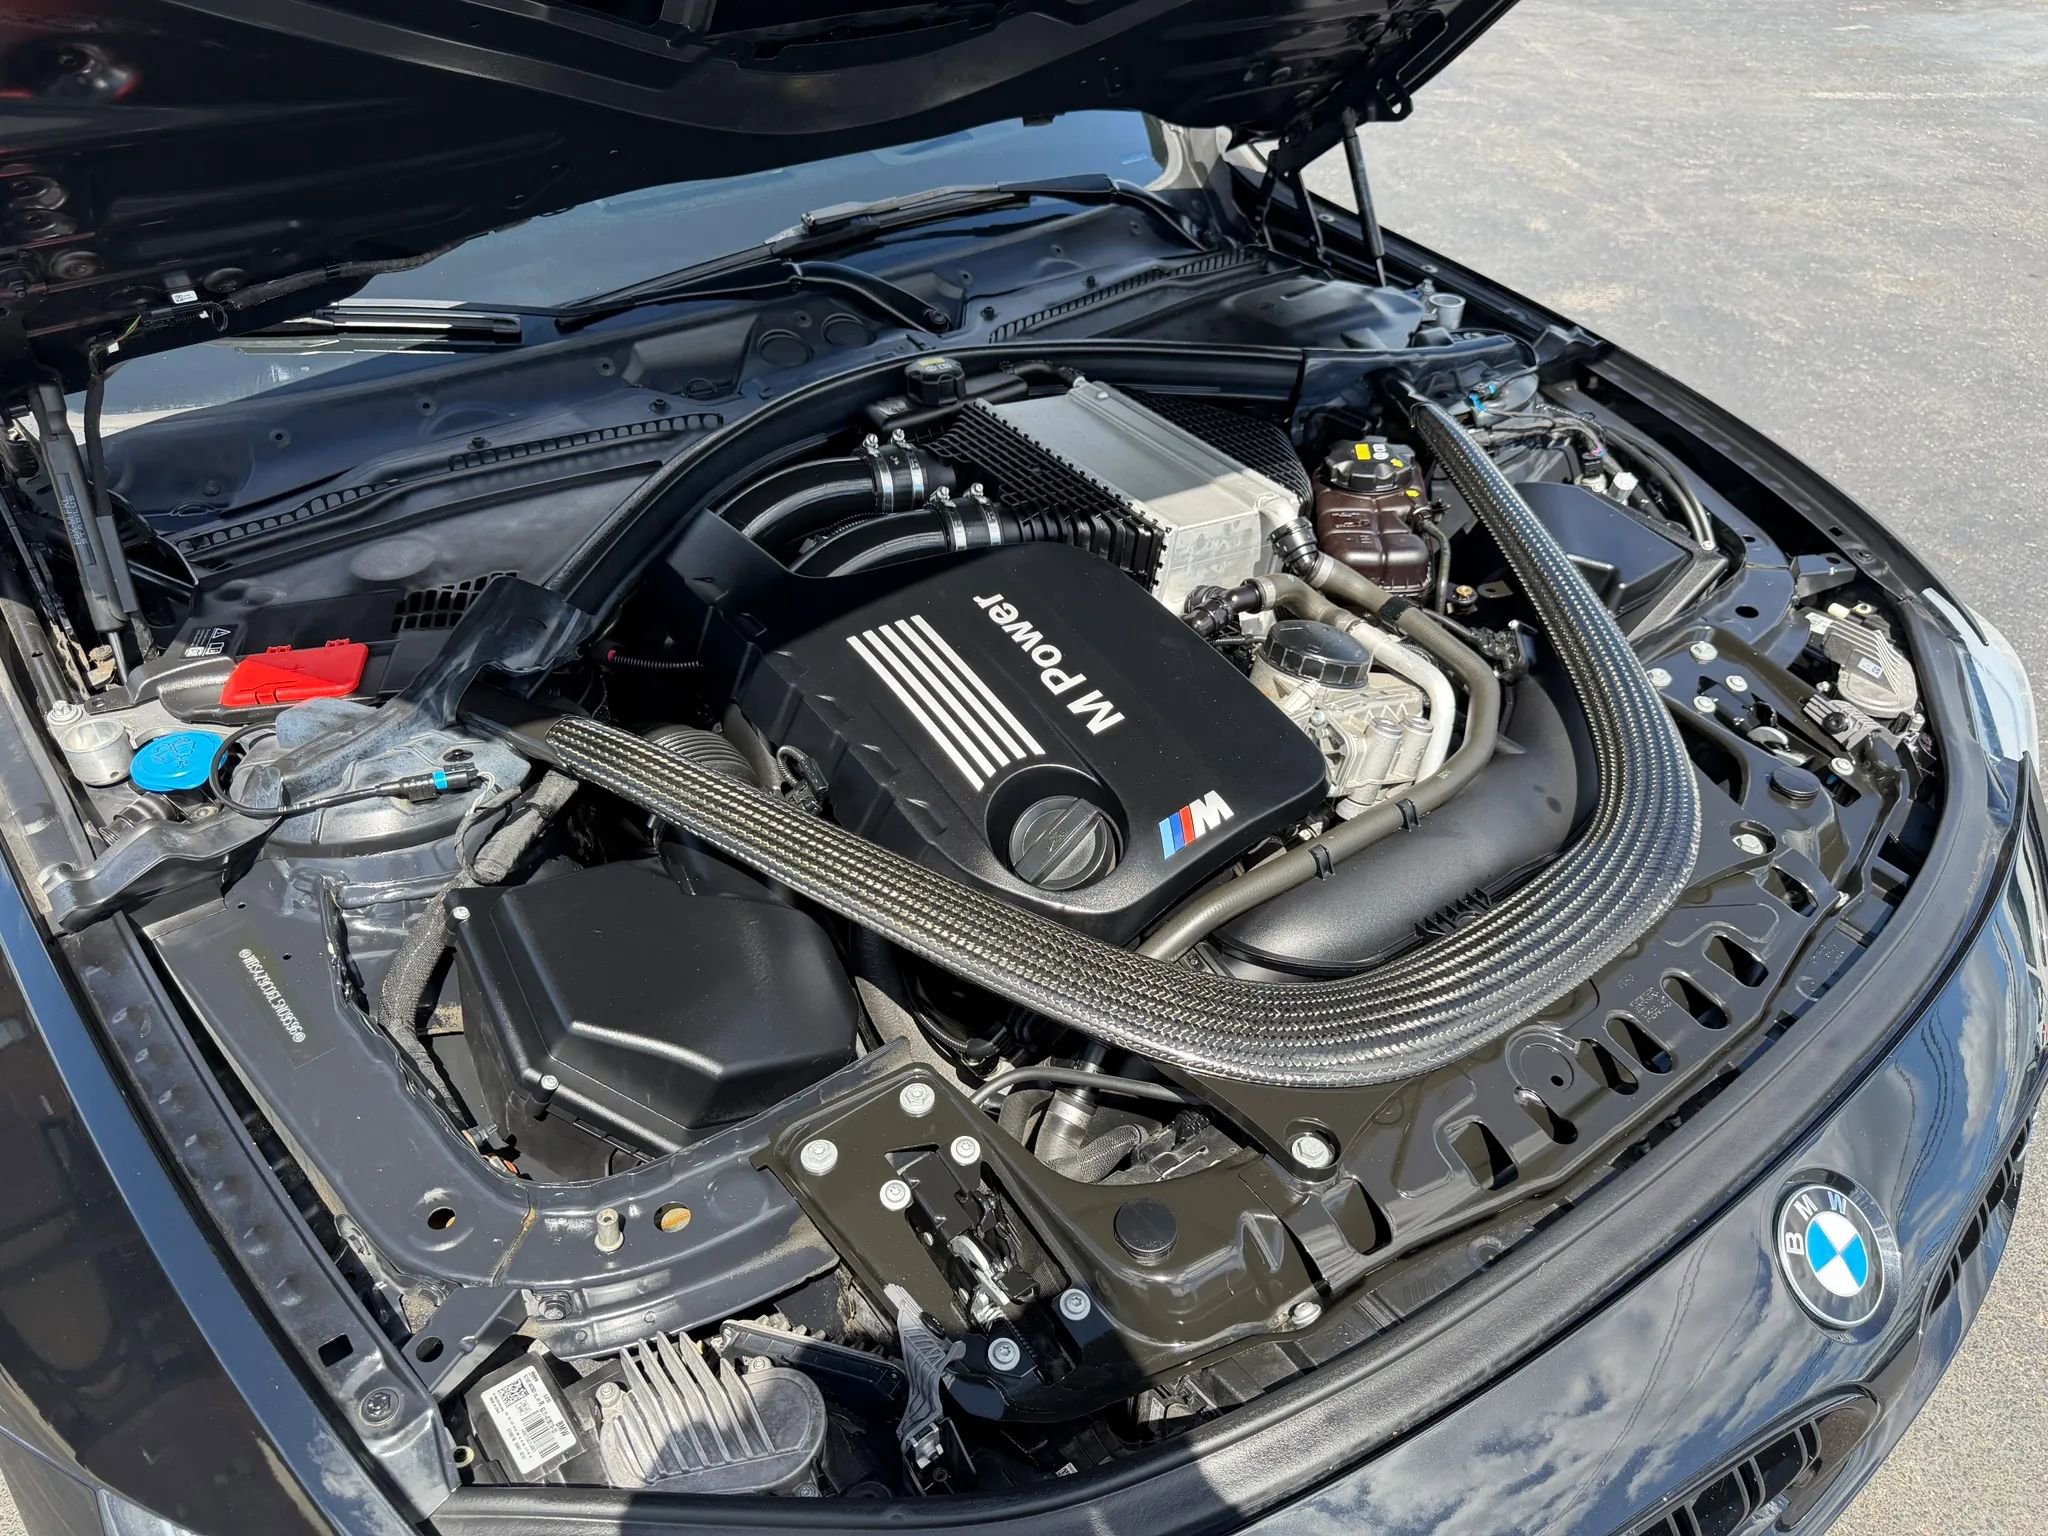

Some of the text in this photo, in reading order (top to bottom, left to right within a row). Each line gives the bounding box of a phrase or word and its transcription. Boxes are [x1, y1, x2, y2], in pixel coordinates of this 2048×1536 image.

[68, 495, 87, 545] STABILUS
[972, 593, 1126, 735] M Power
[1785, 1190, 1847, 1256] BMW
[555, 1420, 570, 1437] BMW
